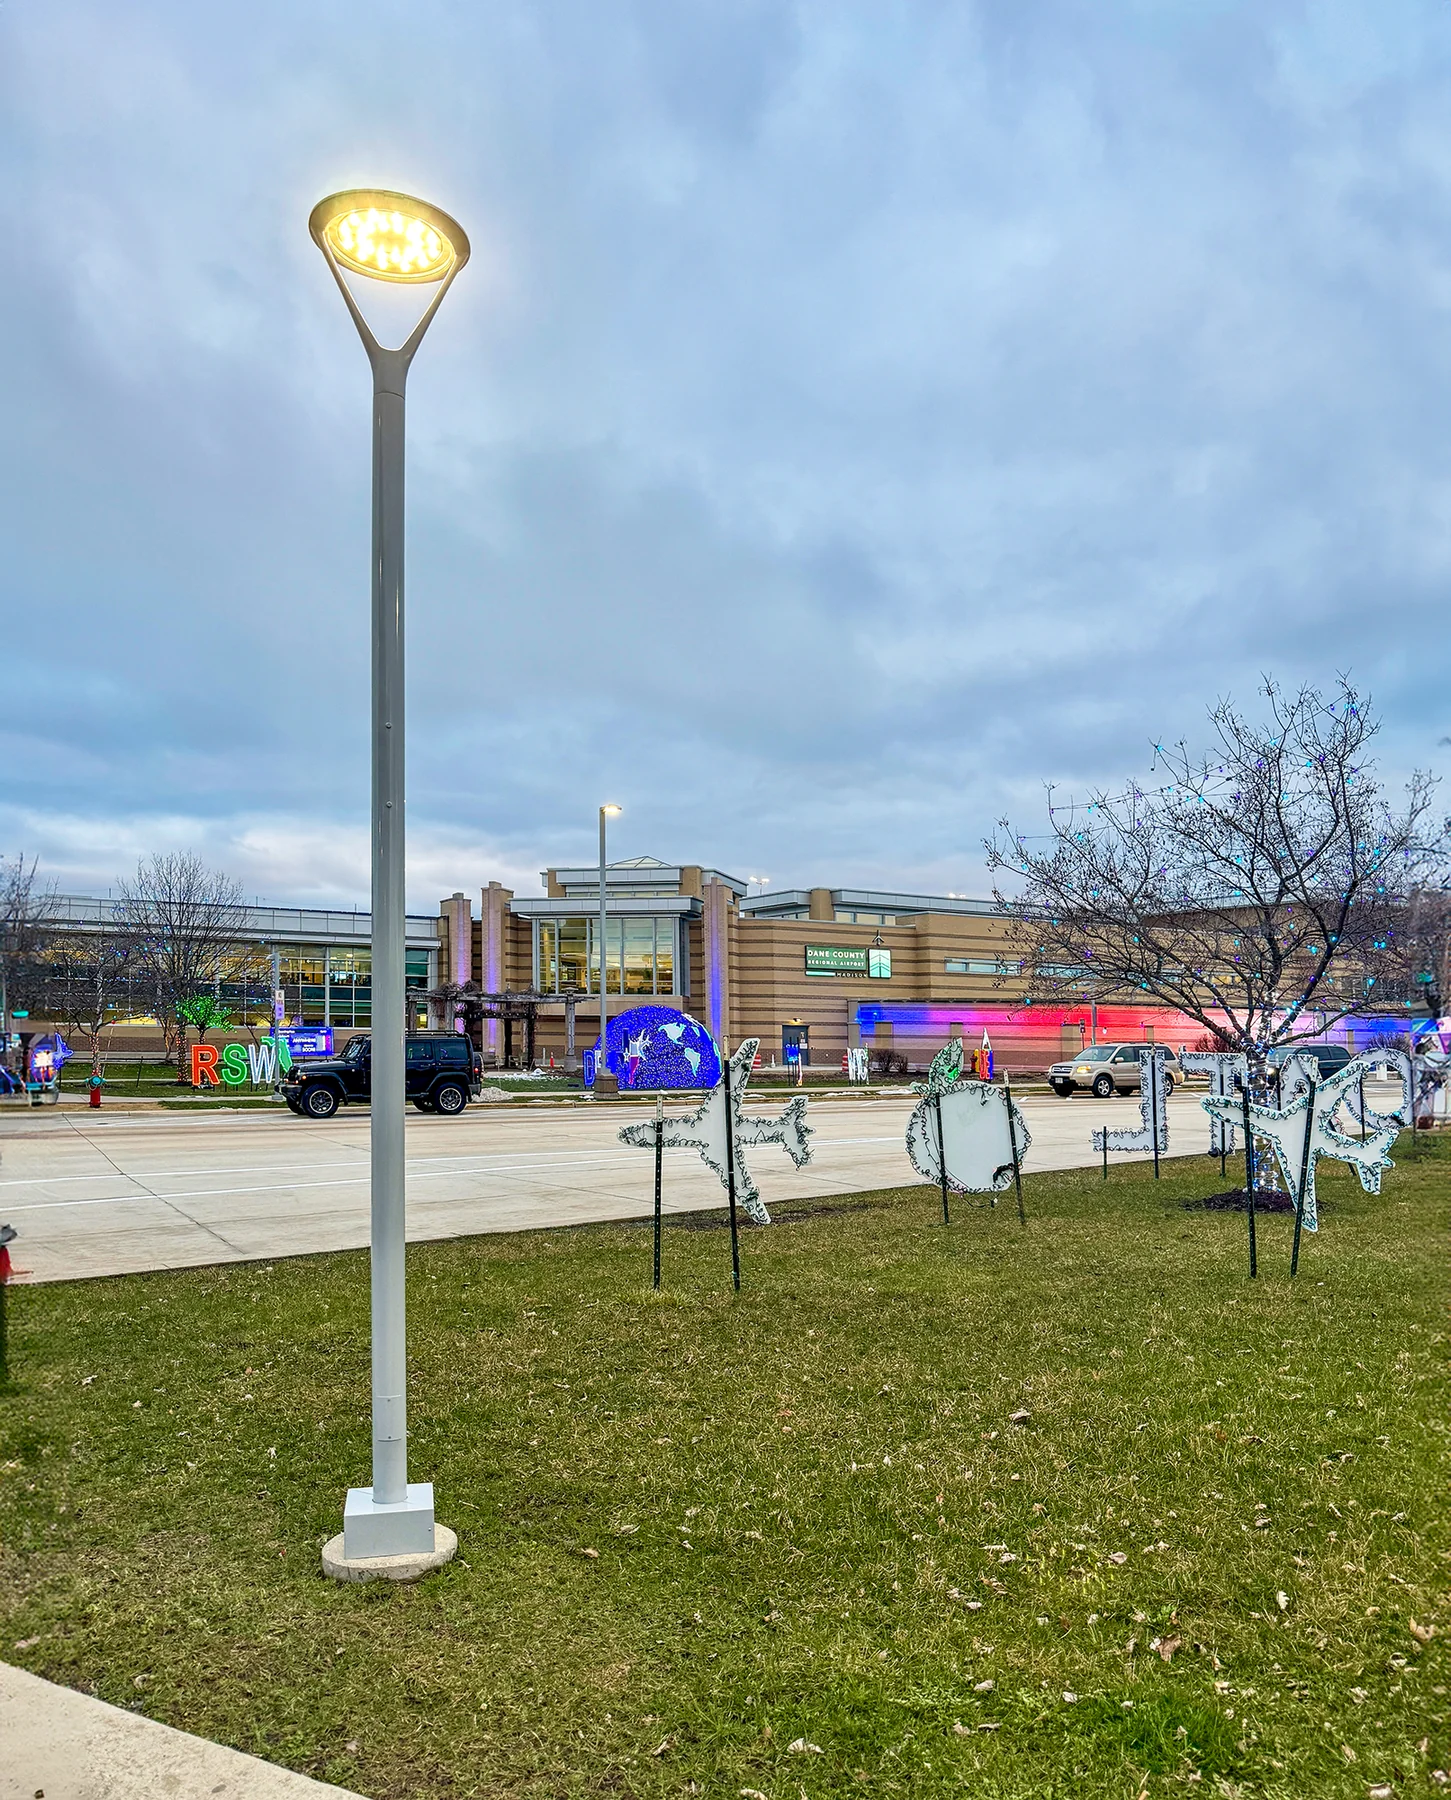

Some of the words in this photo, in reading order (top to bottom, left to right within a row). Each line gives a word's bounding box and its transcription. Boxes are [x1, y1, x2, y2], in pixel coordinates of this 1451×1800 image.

[807, 949, 830, 958] DANE
[832, 951, 865, 959] COUNTY
[191, 1043, 277, 1087] RSW
